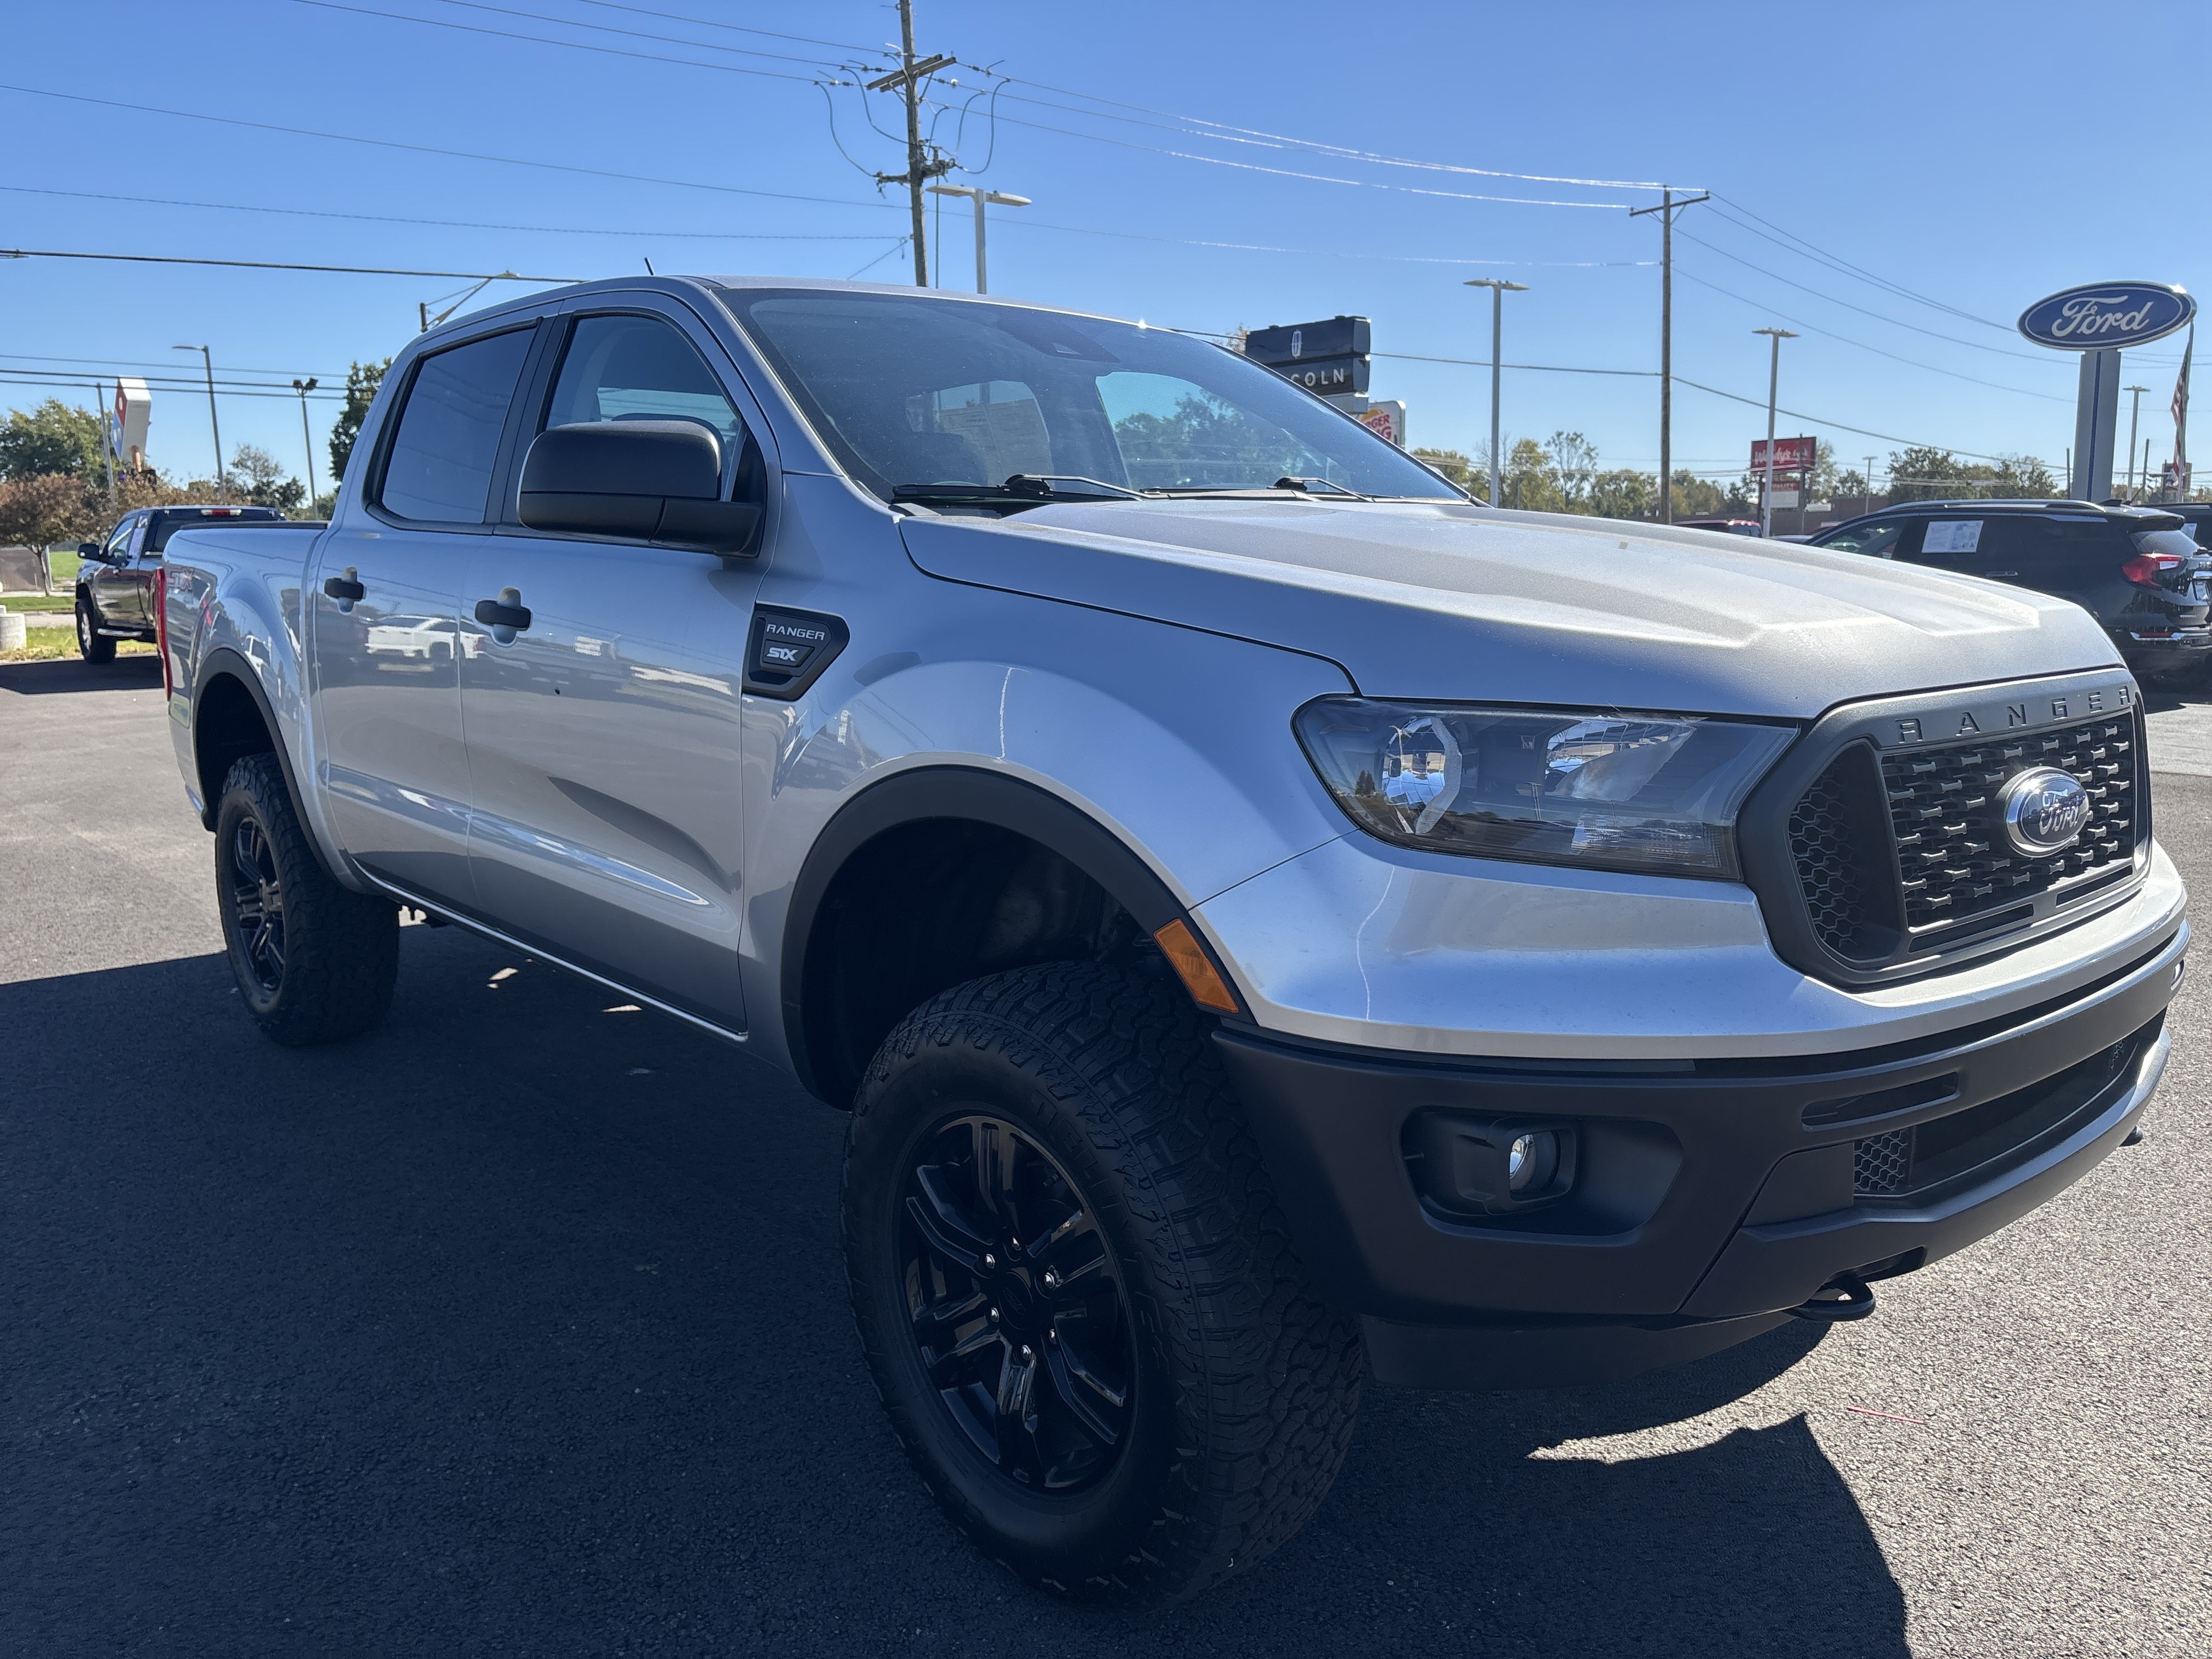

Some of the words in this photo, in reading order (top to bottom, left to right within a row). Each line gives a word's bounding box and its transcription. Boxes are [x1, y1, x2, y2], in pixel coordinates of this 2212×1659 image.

[2051, 295, 2154, 337] Ford
[766, 624, 825, 641] RANGER
[766, 647, 799, 662] STX
[1895, 686, 2131, 744] RANGER
[2039, 788, 2081, 835] Ford
